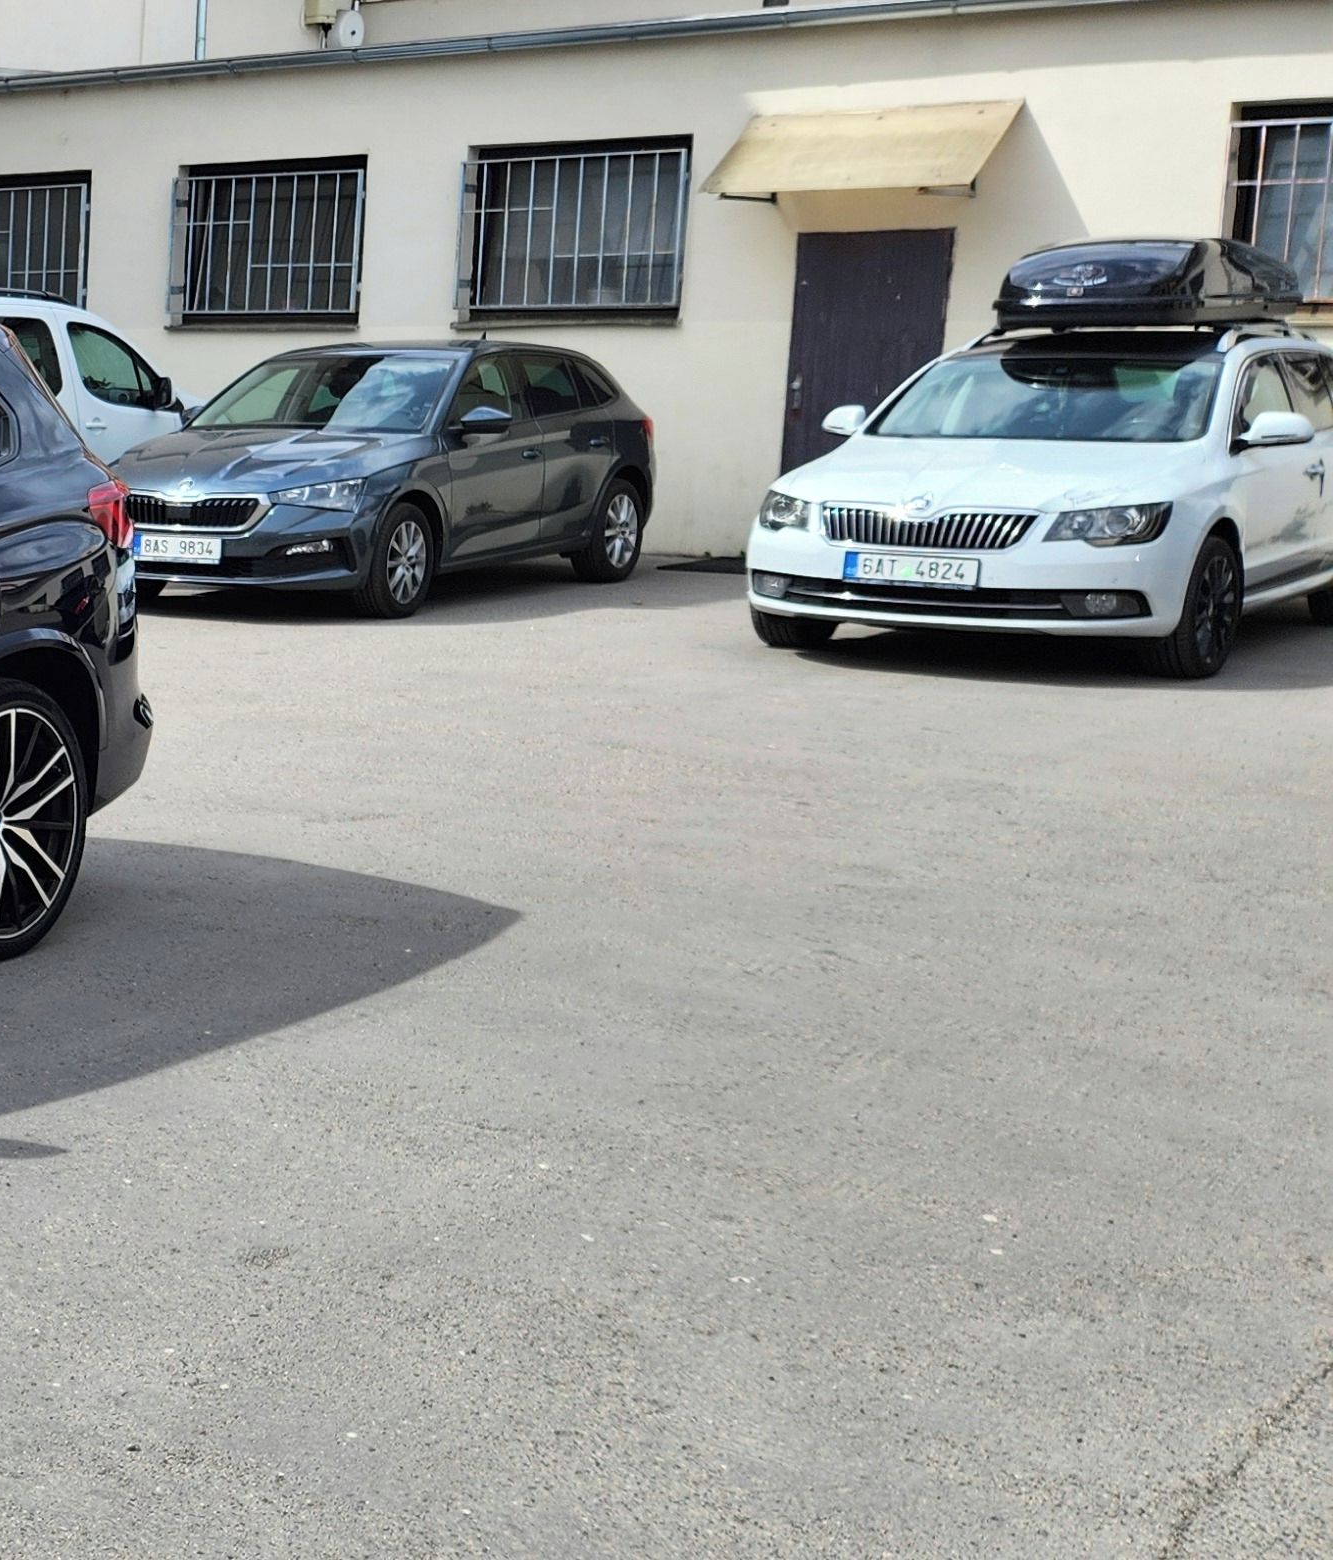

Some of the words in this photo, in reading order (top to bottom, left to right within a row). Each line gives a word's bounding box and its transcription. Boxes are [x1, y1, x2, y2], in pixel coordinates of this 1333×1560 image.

[144, 539, 168, 553] 8AS
[179, 541, 213, 555] 9834
[863, 558, 898, 575] 6AT
[915, 561, 965, 580] 4824
